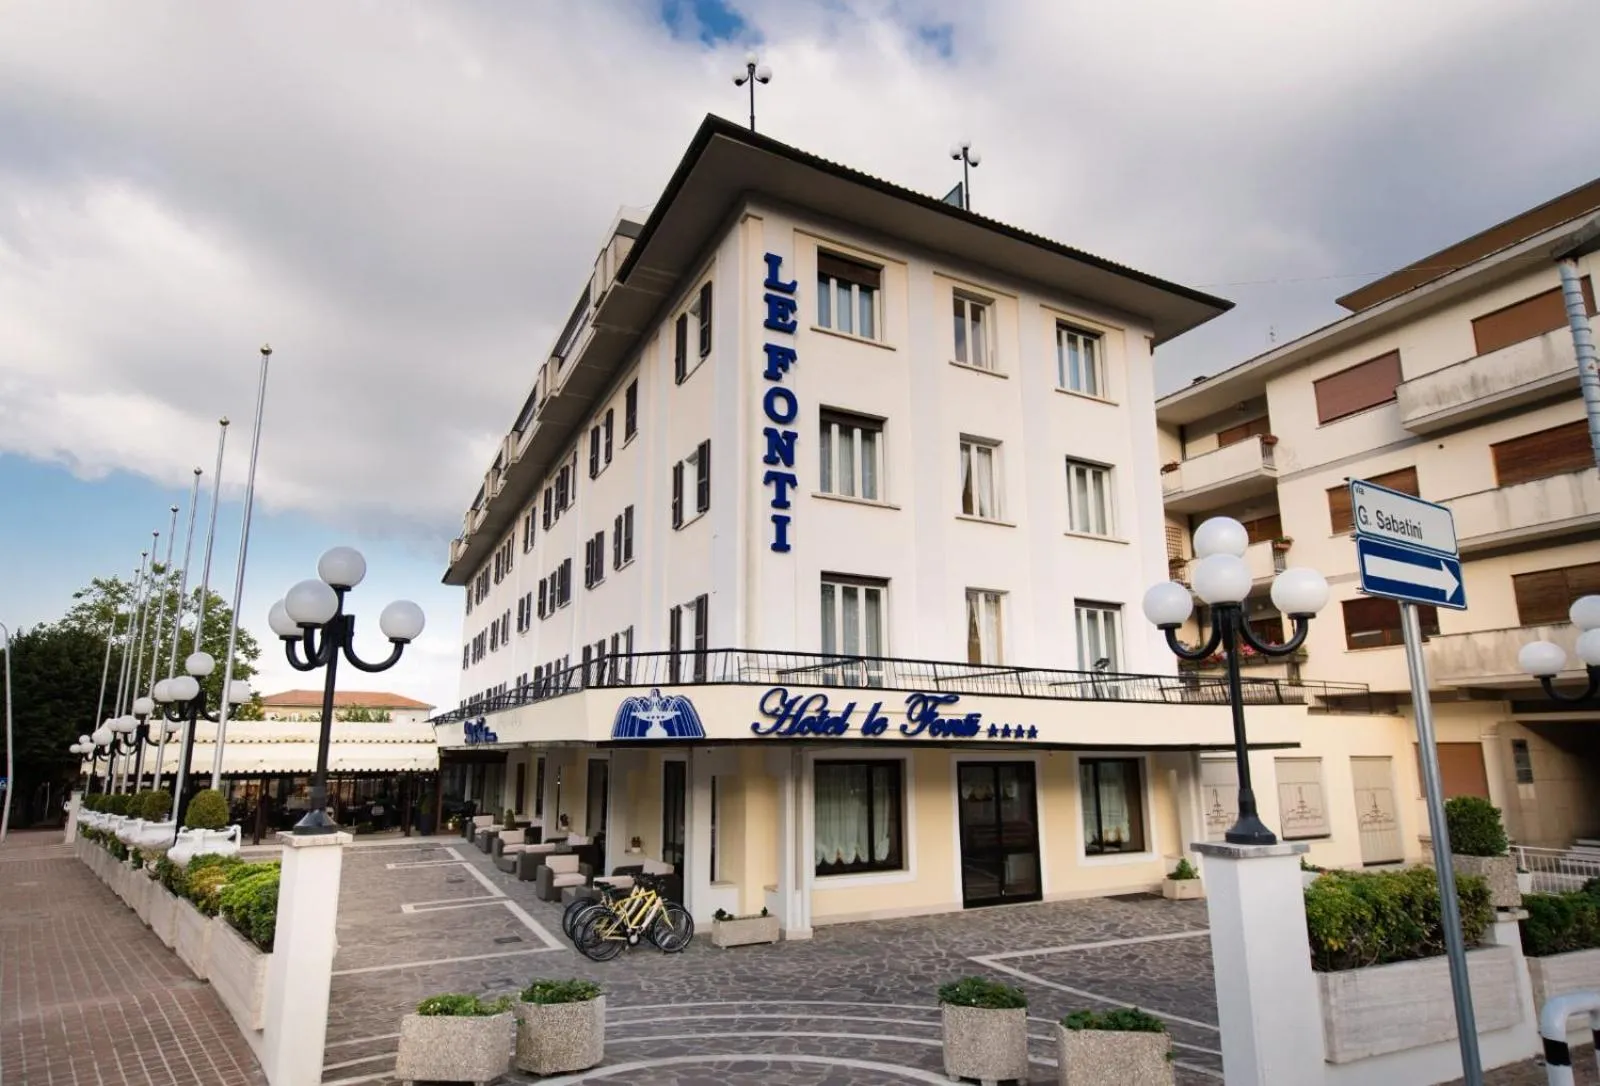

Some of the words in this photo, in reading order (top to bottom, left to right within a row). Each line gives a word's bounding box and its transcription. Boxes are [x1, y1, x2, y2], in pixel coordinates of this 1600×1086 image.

[764, 252, 798, 334] LE
[763, 342, 798, 552] FONTI
[1358, 505, 1372, 525] G.
[1376, 510, 1422, 540] Sabatini
[751, 687, 856, 736] Hotel
